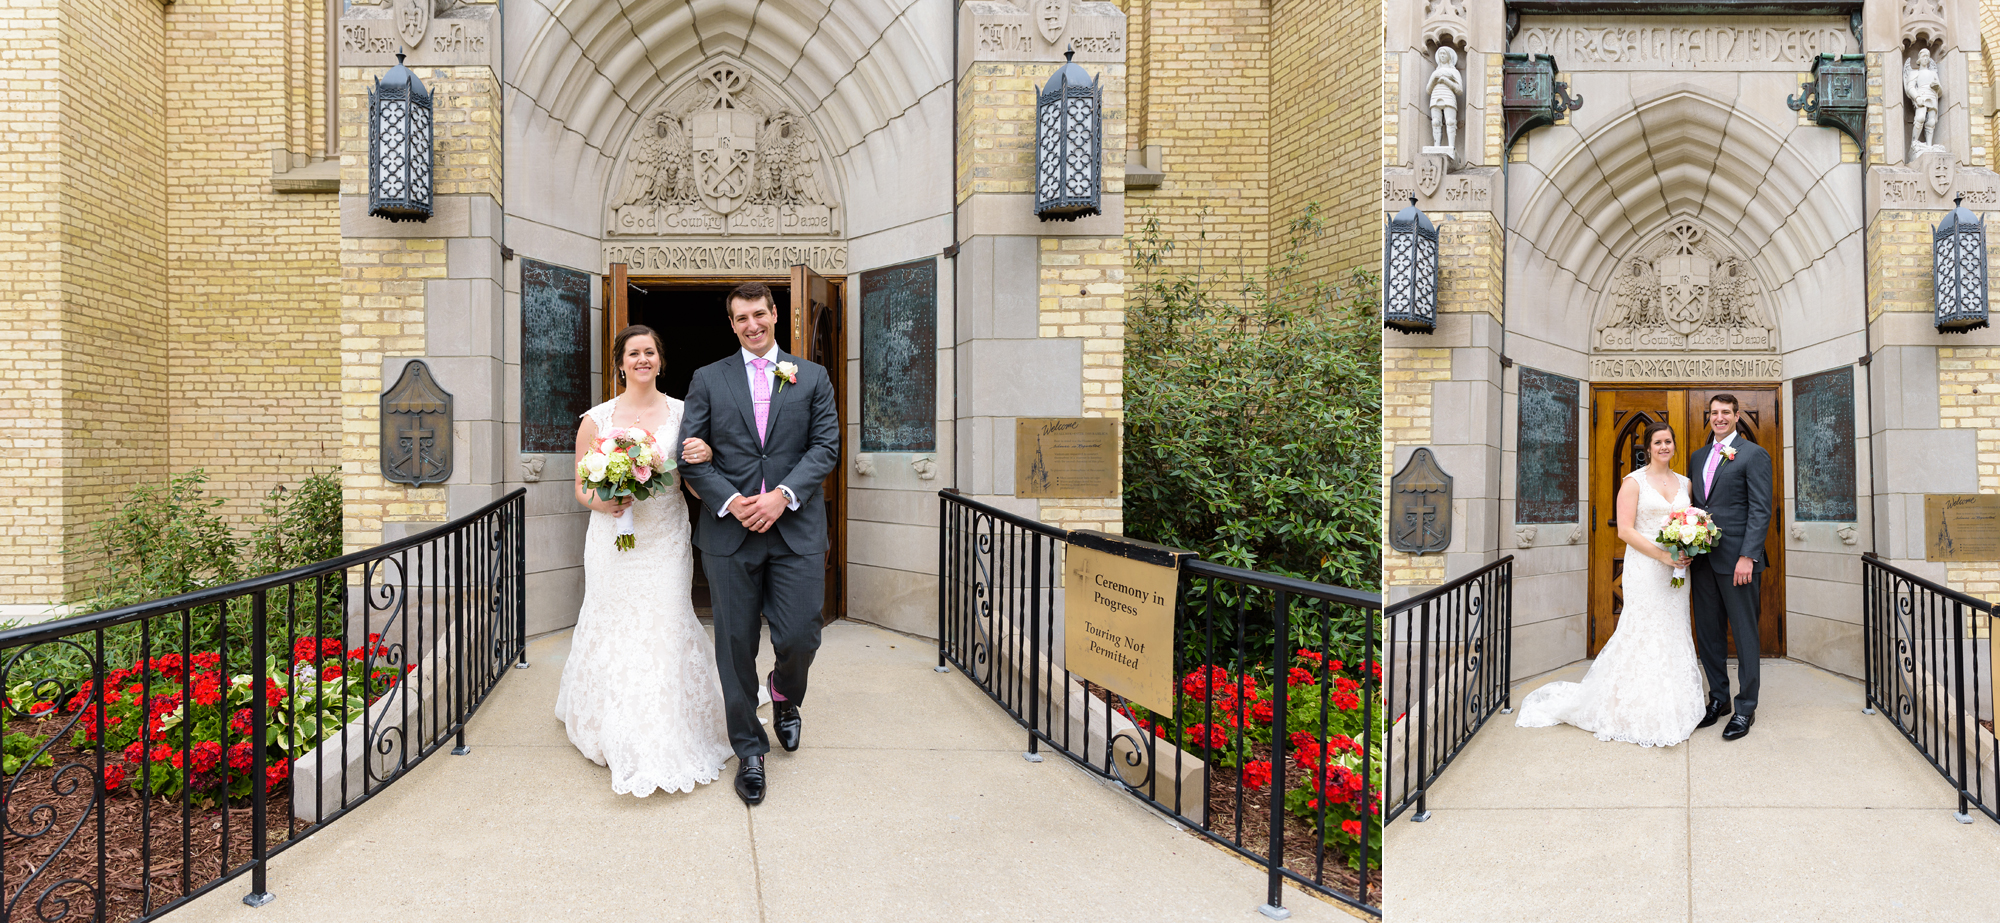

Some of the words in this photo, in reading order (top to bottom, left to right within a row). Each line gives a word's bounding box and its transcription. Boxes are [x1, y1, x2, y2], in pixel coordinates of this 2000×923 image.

[621, 212, 656, 227] God
[664, 212, 722, 230] Country
[731, 212, 775, 228] Notre
[783, 212, 828, 227] Dame
[1604, 332, 1632, 345] God
[1639, 333, 1684, 347] Country
[1691, 333, 1726, 345] Notre
[1731, 333, 1767, 345] Dame
[1042, 420, 1079, 436] Welcome
[1946, 497, 1976, 509] Welcome
[1095, 573, 1149, 604] Ceremony
[1153, 591, 1165, 607] in
[1094, 591, 1138, 616] Progress
[1085, 621, 1121, 648] Touring
[1124, 635, 1146, 654] Not
[1090, 640, 1139, 670] Permitted
